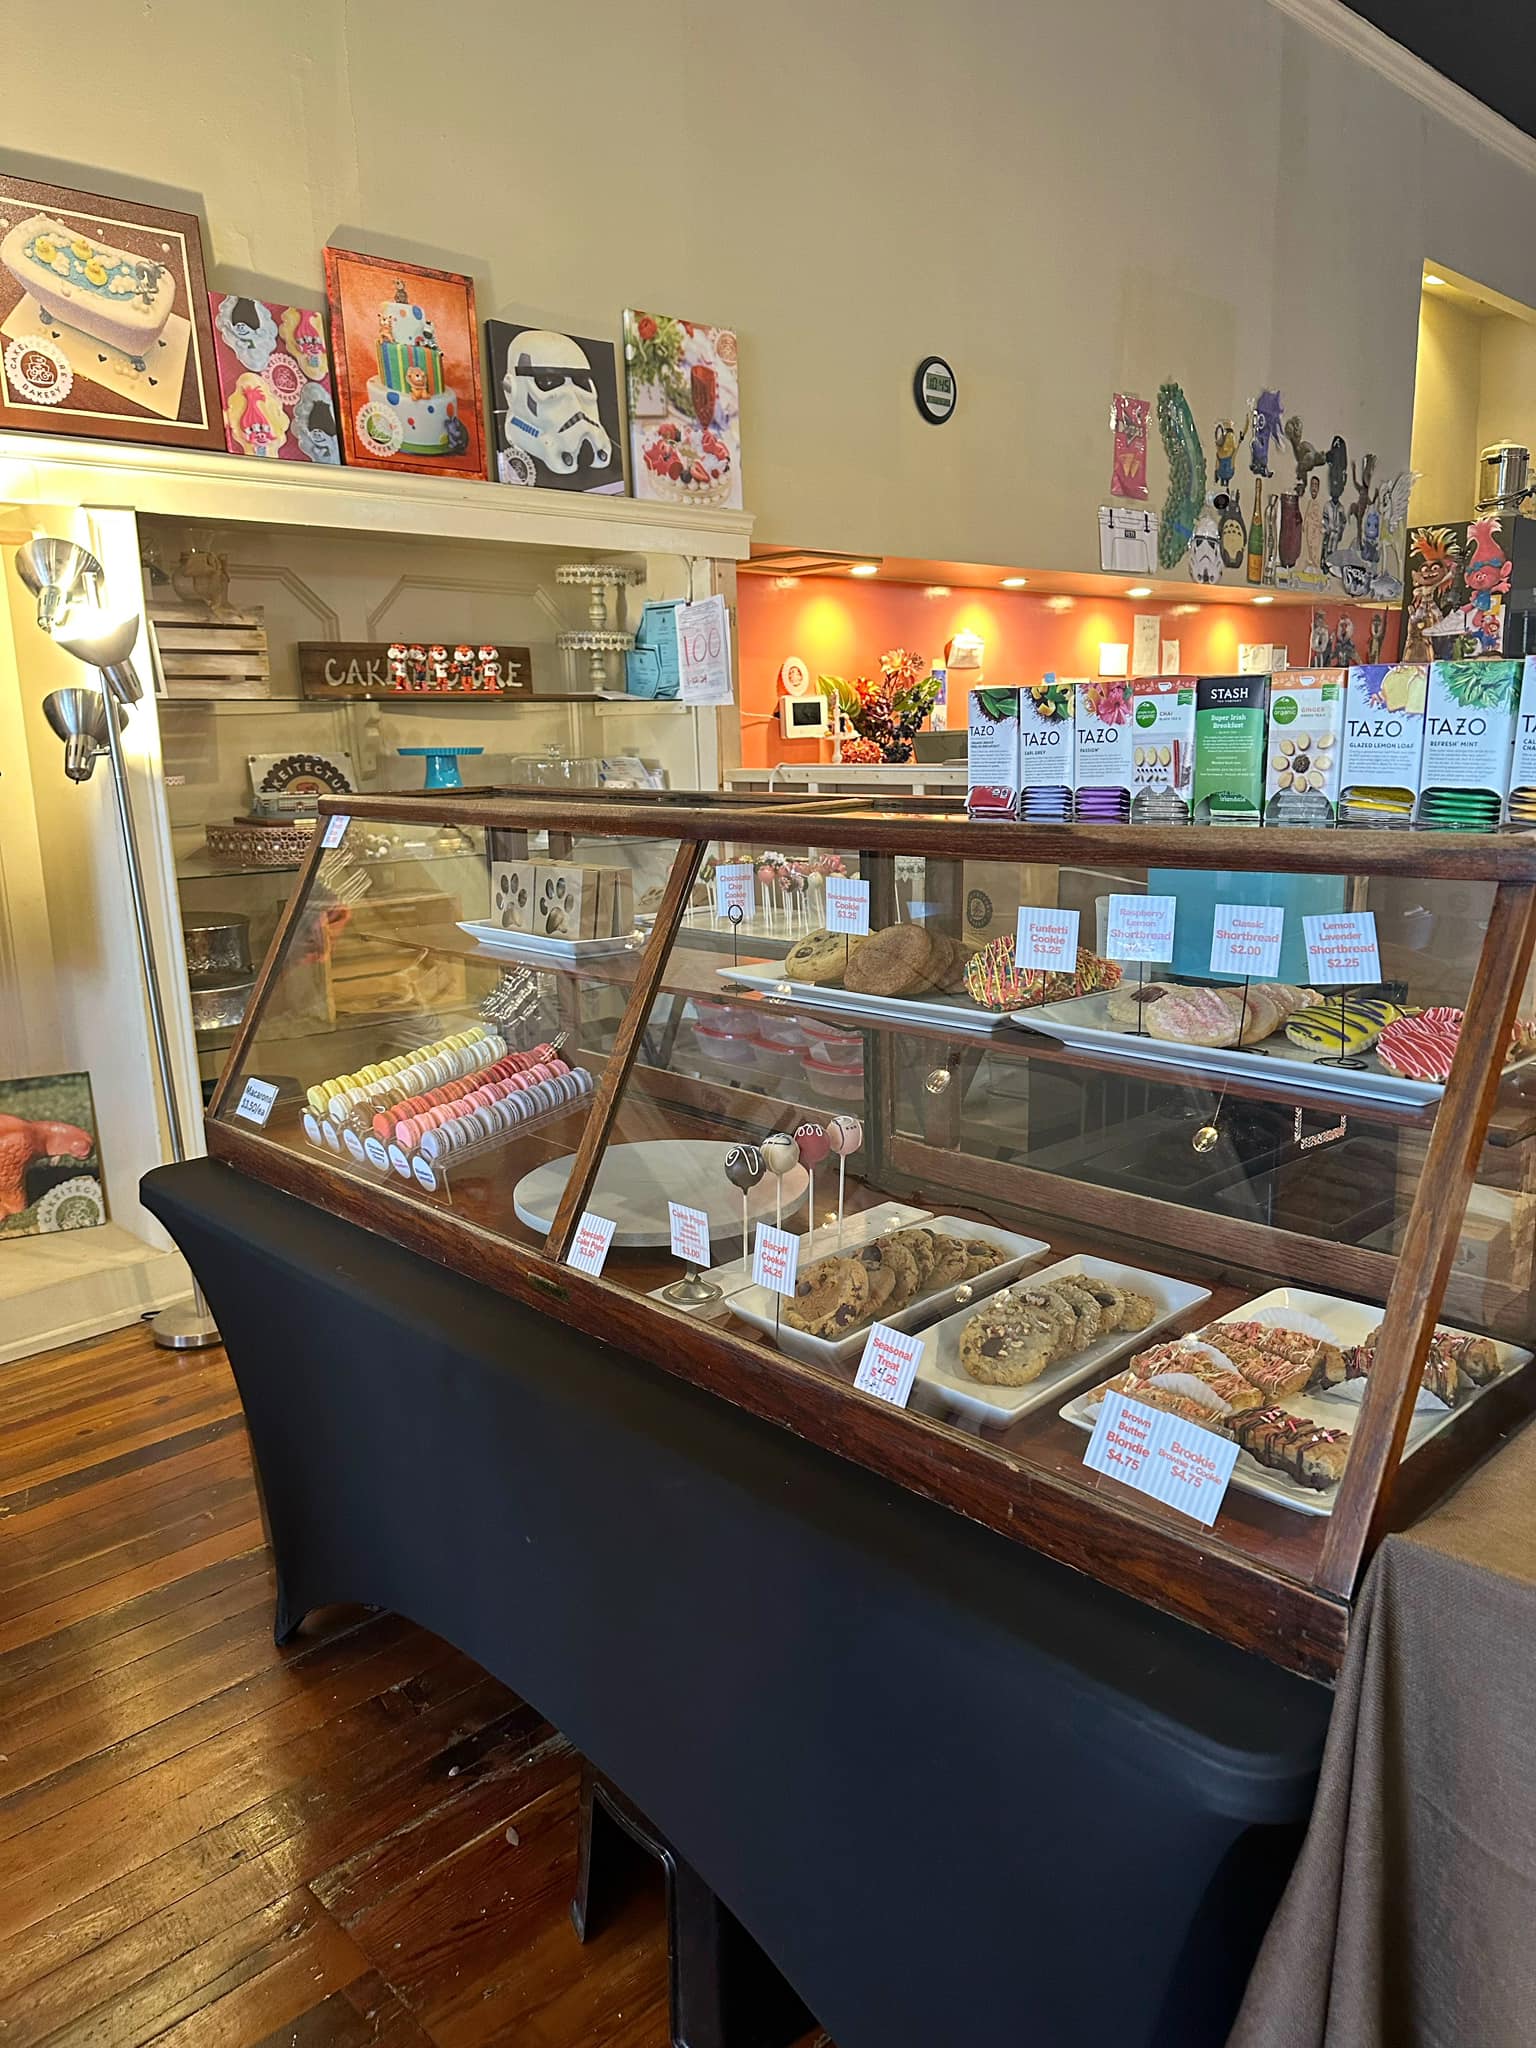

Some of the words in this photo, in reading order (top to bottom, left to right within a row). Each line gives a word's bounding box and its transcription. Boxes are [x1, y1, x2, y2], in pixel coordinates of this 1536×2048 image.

[22, 383, 61, 399] BAKERY
[683, 626, 721, 668] 100
[1210, 687, 1249, 699] STASH
[1230, 713, 1247, 721] Irish
[969, 725, 995, 737] TAZO
[1347, 720, 1402, 737] TAZO
[1427, 718, 1487, 736] TAZO
[1022, 730, 1060, 747] TAZO
[1077, 728, 1119, 744] TAZO
[725, 891, 747, 899] Cookie
[835, 901, 860, 911] Cookie
[1119, 908, 1165, 919] Raspberry
[1029, 923, 1069, 934] Funfetti
[1126, 919, 1156, 927] Lemon
[1232, 919, 1265, 928] Classic
[1322, 922, 1356, 930] Lemon
[1030, 934, 1066, 944] Cookie
[1110, 929, 1172, 940] Shortbread
[1216, 929, 1280, 943] Shortbread
[1319, 932, 1362, 941] Lavender
[1033, 944, 1062, 955] $3.25
[1230, 944, 1261, 956] $2.00
[1310, 943, 1376, 954] Shortbread
[1327, 957, 1360, 968] $2.25
[672, 1209, 688, 1220] Cake
[689, 1214, 706, 1226] Pops
[580, 1227, 606, 1243] Specialty
[576, 1235, 590, 1247] Cake
[590, 1240, 604, 1253] Pops
[762, 1239, 789, 1254] Biscoff
[761, 1252, 786, 1267] Cookie
[872, 1337, 913, 1362] Seasonal
[877, 1354, 900, 1372] Treat
[1120, 1409, 1152, 1429] Brown
[1118, 1421, 1148, 1440] Butter
[1105, 1430, 1150, 1458] Blondie
[1106, 1448, 1140, 1471] $4.75
[1171, 1441, 1217, 1471] Brookie
[1158, 1448, 1189, 1469] Brownie
[1195, 1466, 1223, 1485] Cookie
[1170, 1465, 1203, 1488] $4.75
